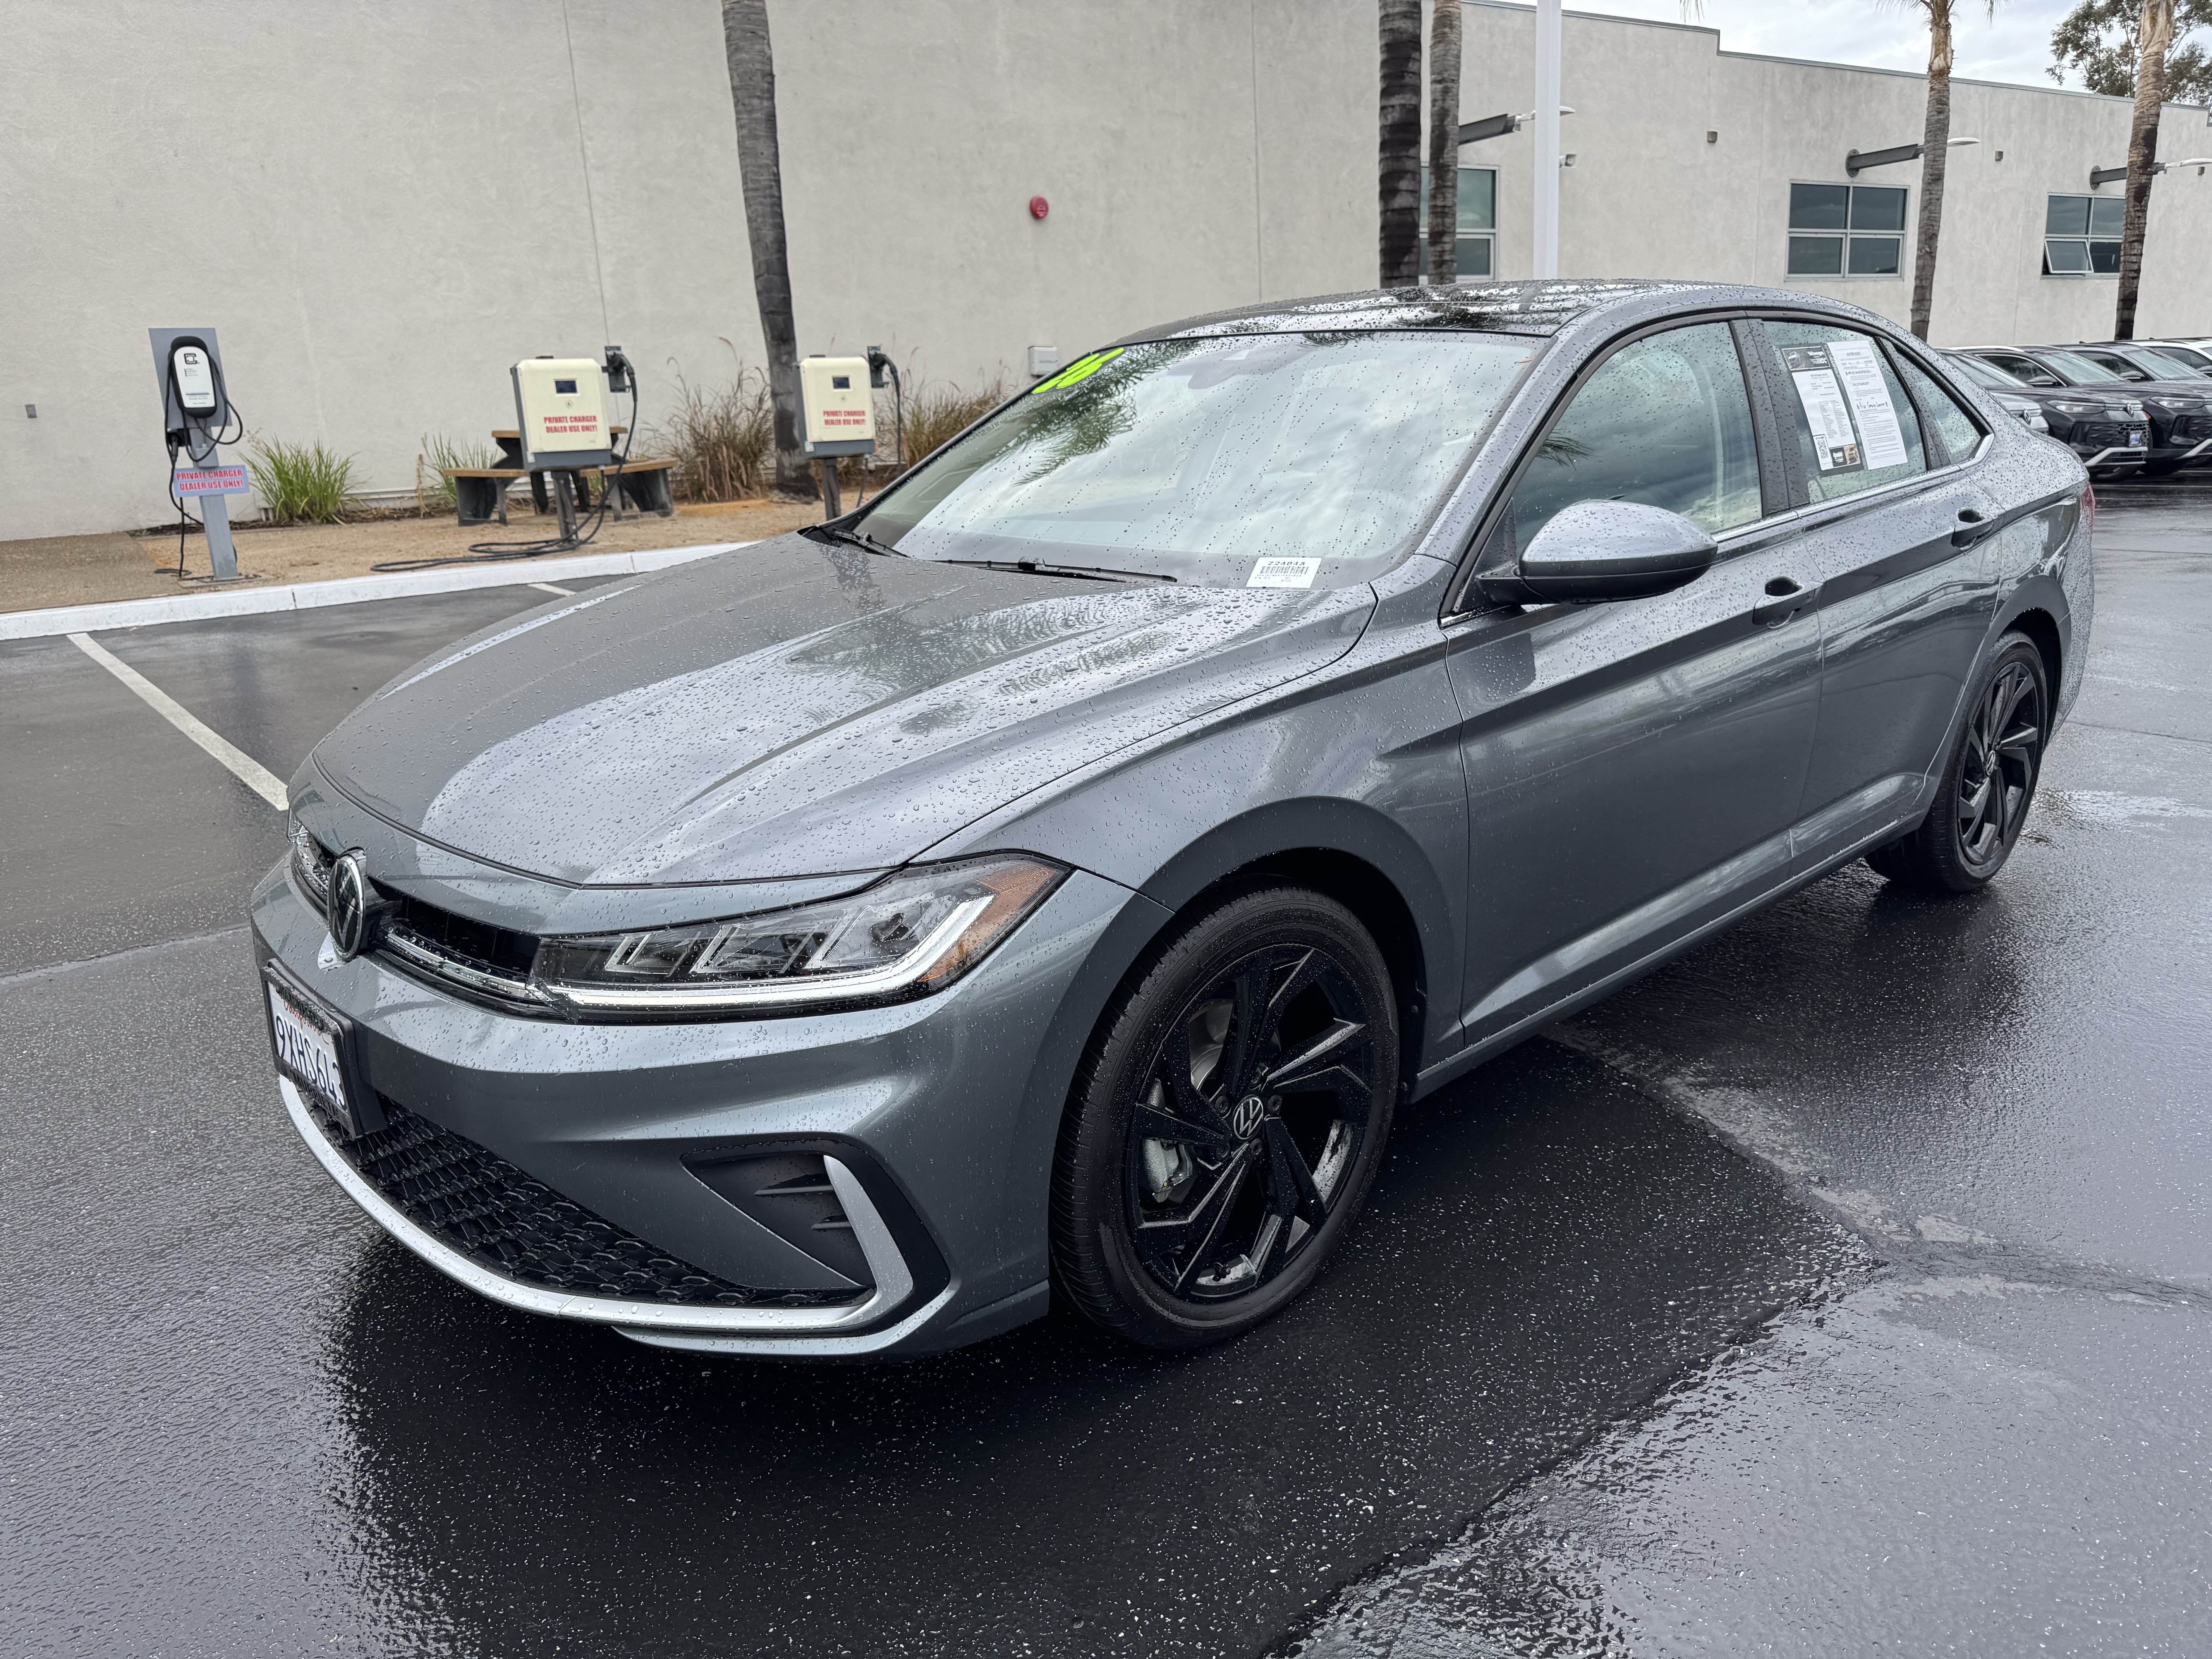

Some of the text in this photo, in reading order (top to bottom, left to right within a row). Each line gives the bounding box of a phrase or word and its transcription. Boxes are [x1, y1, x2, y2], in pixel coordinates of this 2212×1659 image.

[176, 469, 243, 480] PRIVATE CHARGER
[179, 479, 244, 491] DEALER USE ONLY!
[276, 1015, 347, 1111] 9XHS643
